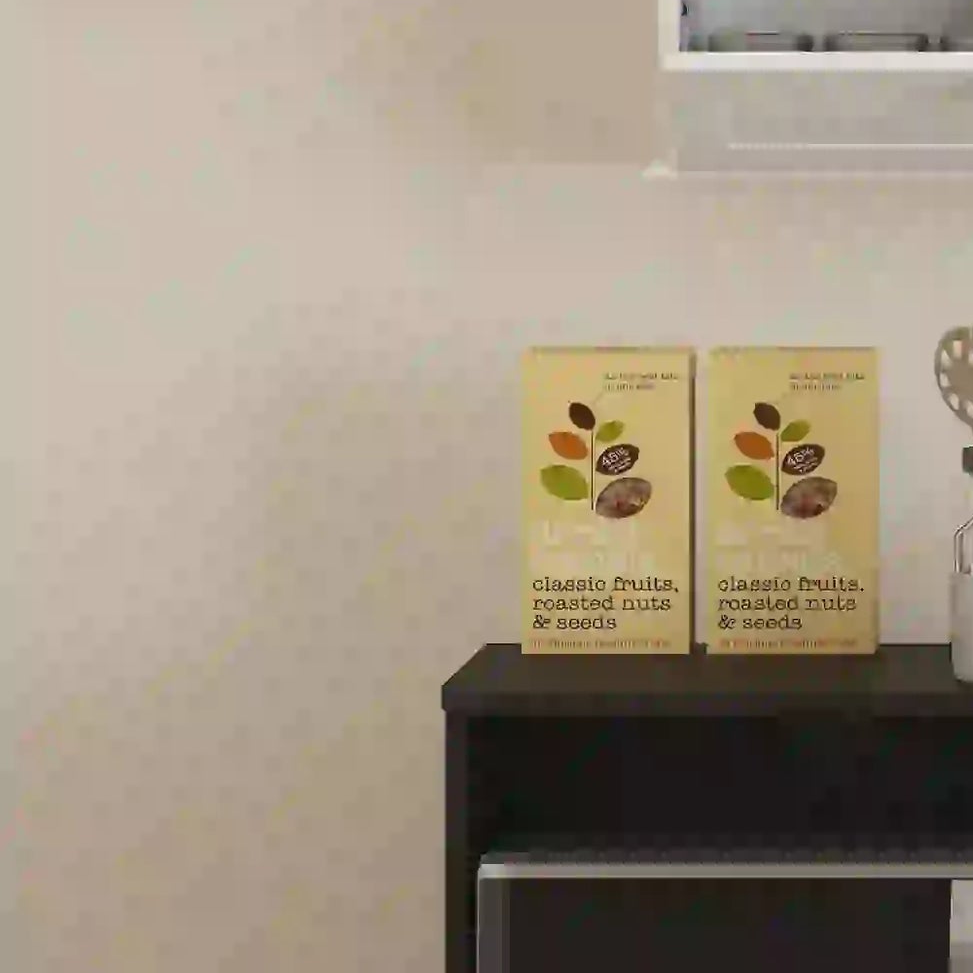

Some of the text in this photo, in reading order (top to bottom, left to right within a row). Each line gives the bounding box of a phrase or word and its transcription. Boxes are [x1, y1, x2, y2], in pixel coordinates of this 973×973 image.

[532, 576, 606, 592] classic
[718, 576, 791, 592] classic
[532, 595, 671, 611] roasted nuts
[718, 595, 857, 611] roasted nuts
[532, 614, 617, 629] & seeds
[718, 614, 803, 629] & seeds
